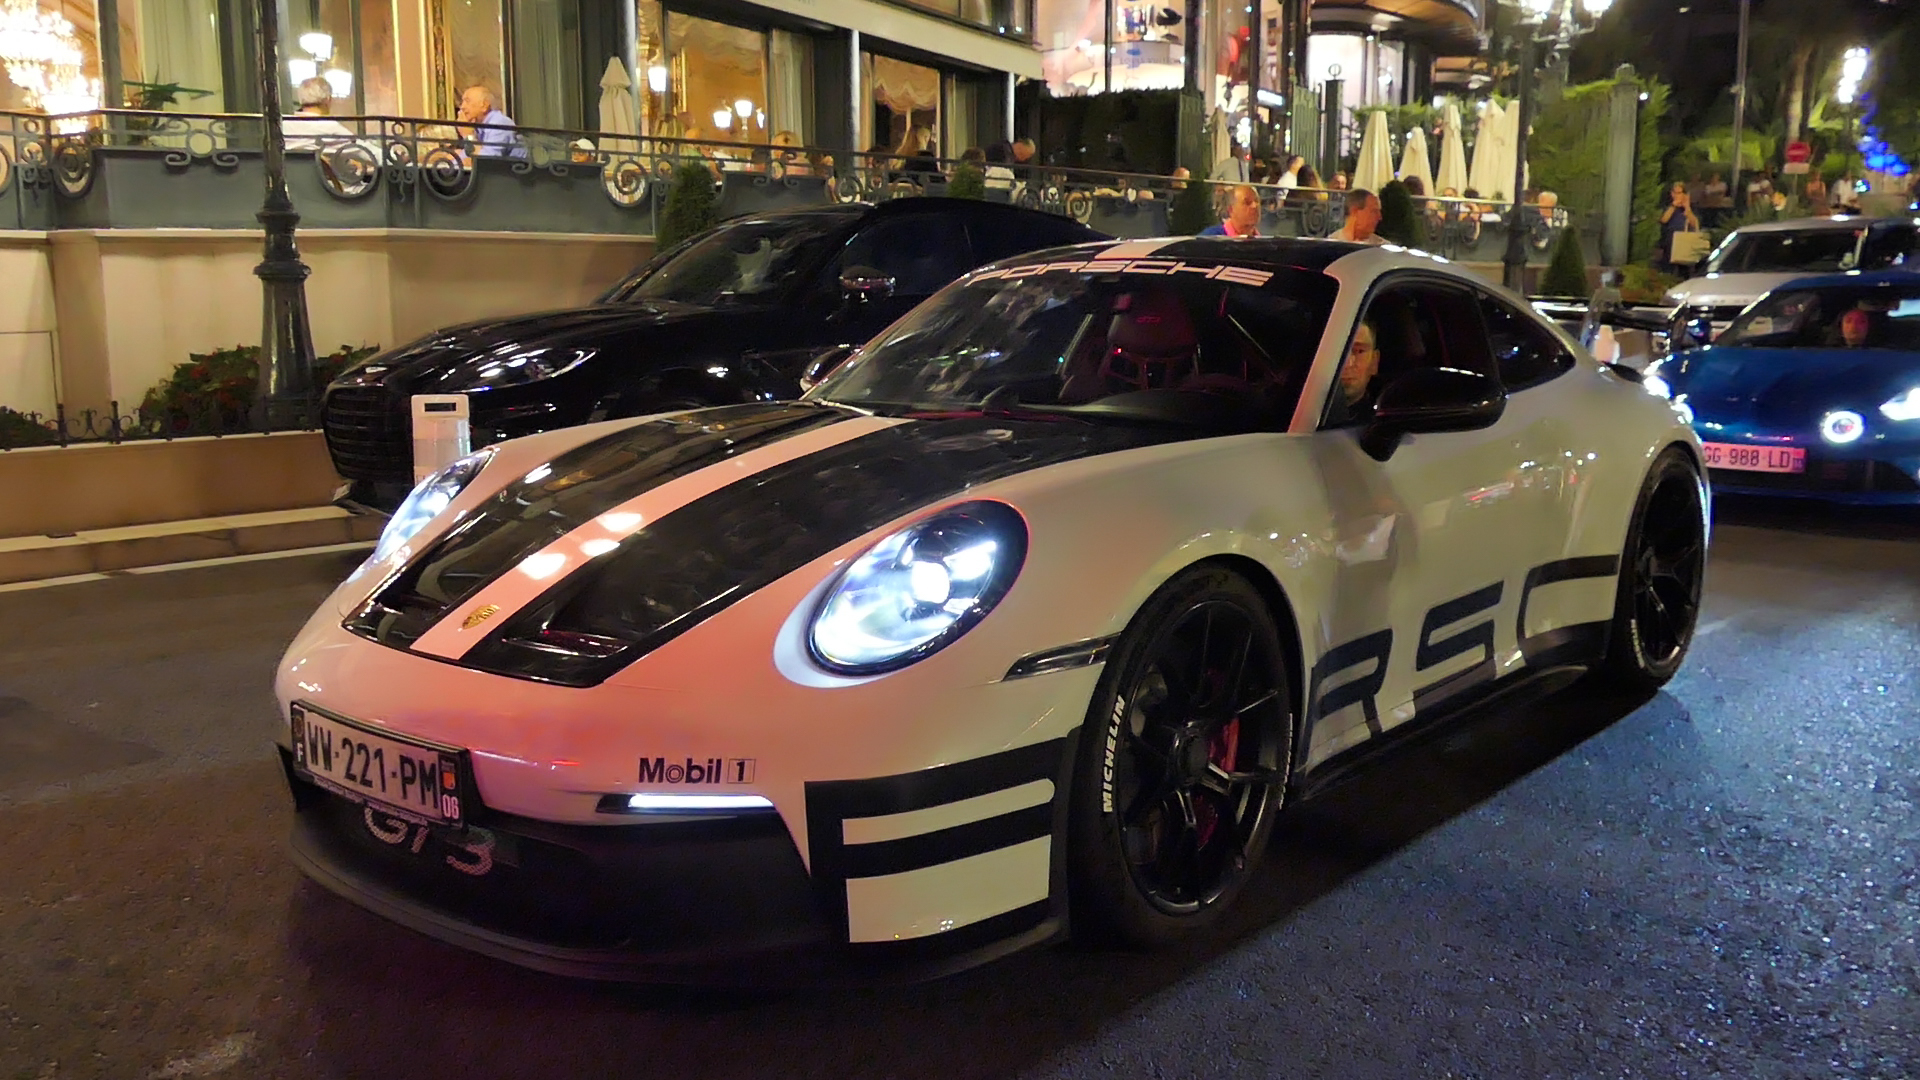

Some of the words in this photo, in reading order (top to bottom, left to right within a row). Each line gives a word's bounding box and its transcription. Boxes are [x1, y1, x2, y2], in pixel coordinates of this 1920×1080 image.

[964, 260, 1274, 287] PORSCHE
[1103, 695, 1125, 812] MICHELIN
[638, 757, 722, 784] Mobil
[442, 794, 460, 819] 06
